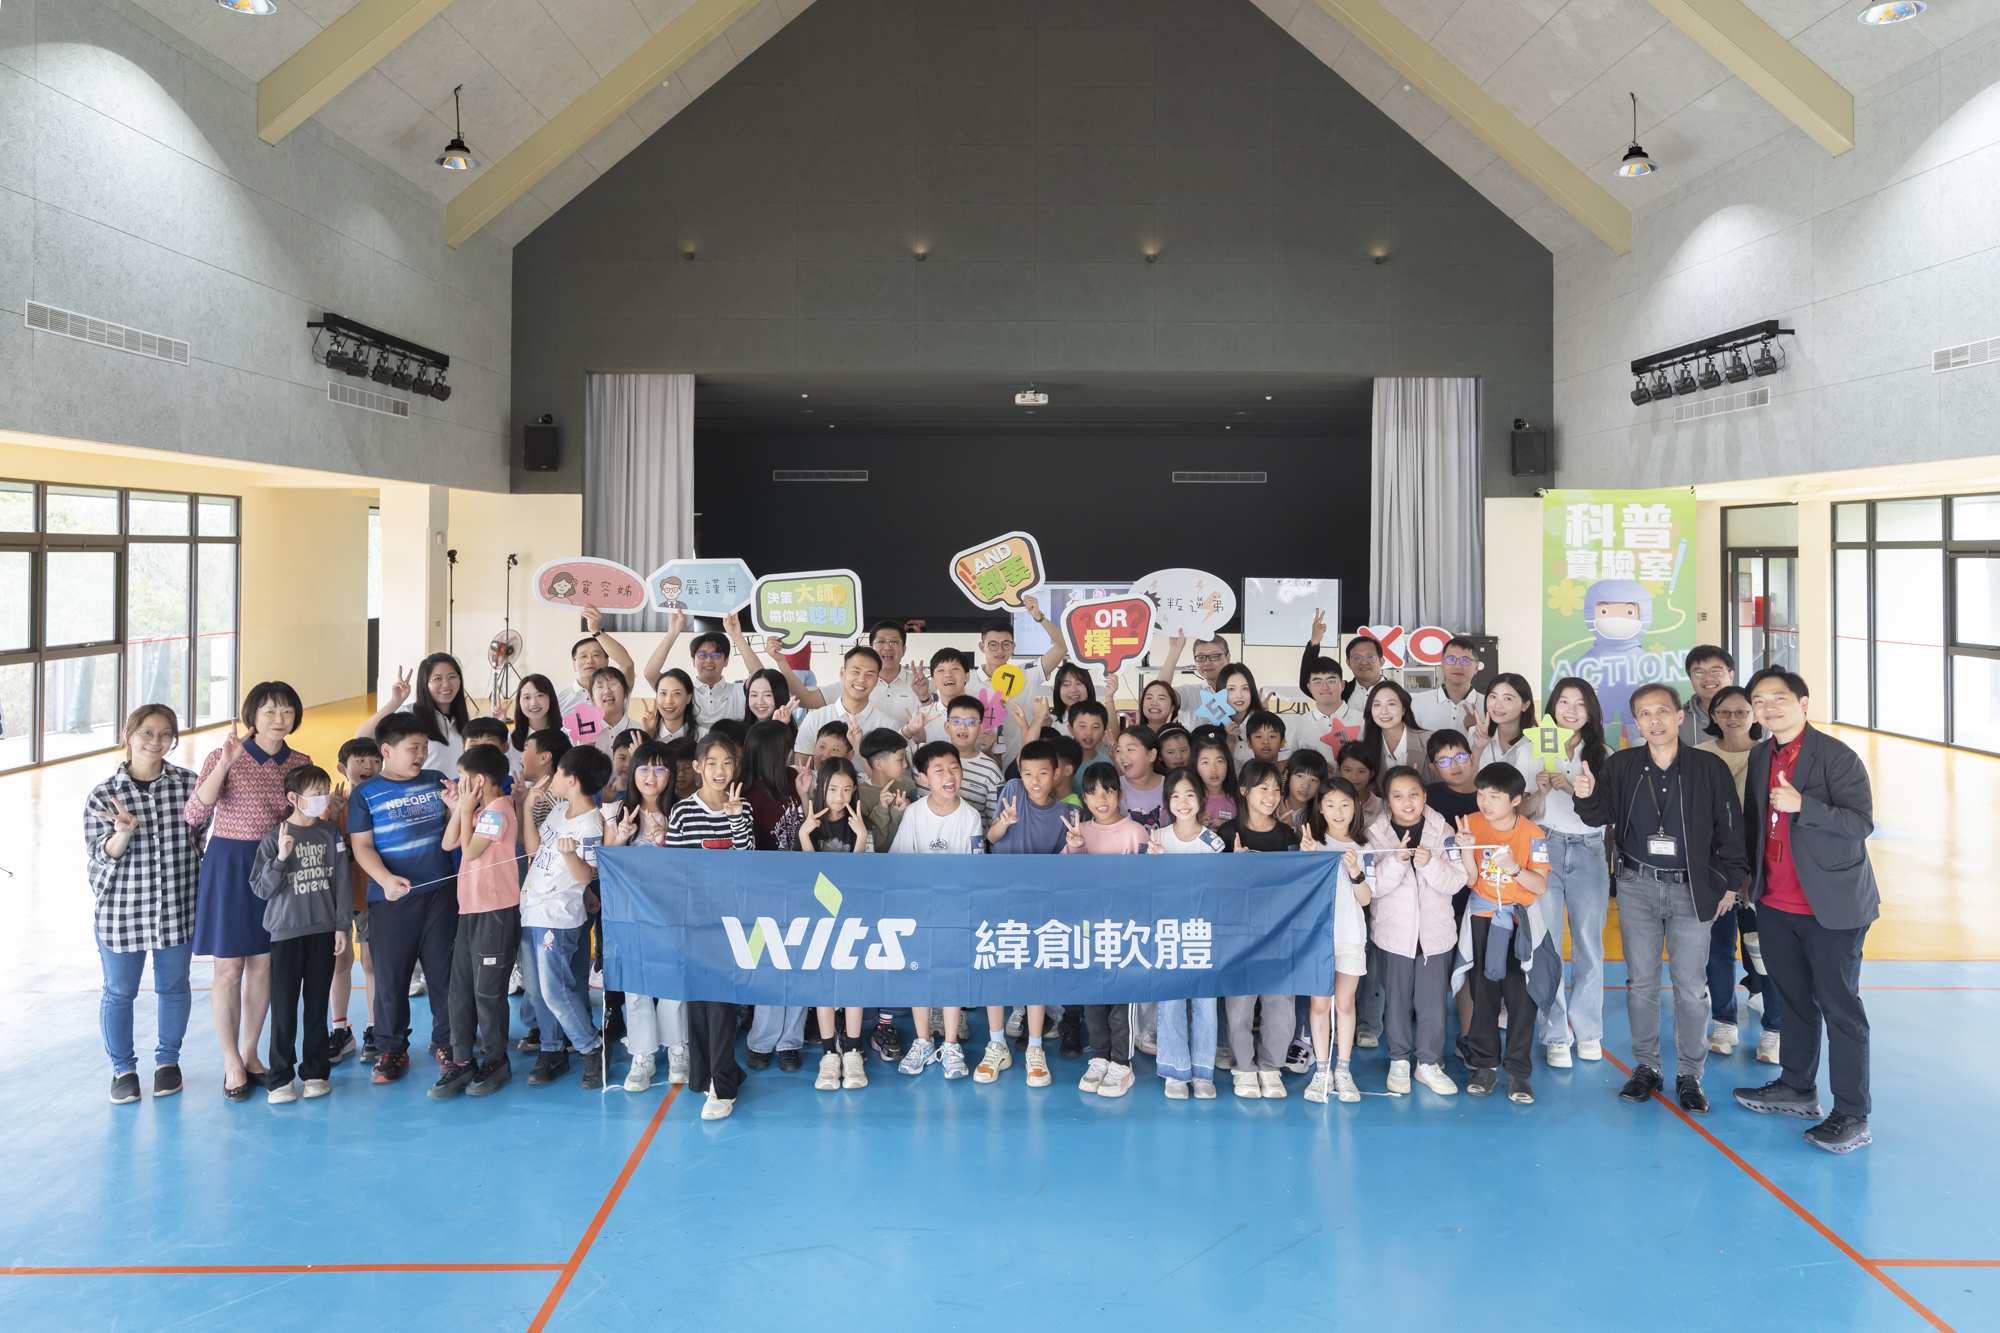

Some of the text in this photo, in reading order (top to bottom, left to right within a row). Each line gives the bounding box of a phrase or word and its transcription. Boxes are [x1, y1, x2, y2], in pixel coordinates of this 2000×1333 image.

[1566, 503, 1673, 549] 科普
[974, 543, 1012, 575] AND
[1565, 549, 1673, 581] 實驗室
[685, 577, 738, 596] 嚴謹哥
[975, 554, 1031, 601] 都要
[767, 583, 836, 605] 決策大師
[1167, 595, 1224, 613] 叛逆弟
[768, 605, 848, 628] 帶你變聰明
[1094, 608, 1128, 628] OR
[1084, 628, 1139, 657] 擇一
[1549, 649, 1691, 691] ACTION
[1001, 671, 1016, 697] 7
[983, 707, 996, 726] 4
[1205, 698, 1227, 721] 5
[293, 878, 330, 895] foreve
[973, 918, 1214, 970] 緯創軟體
